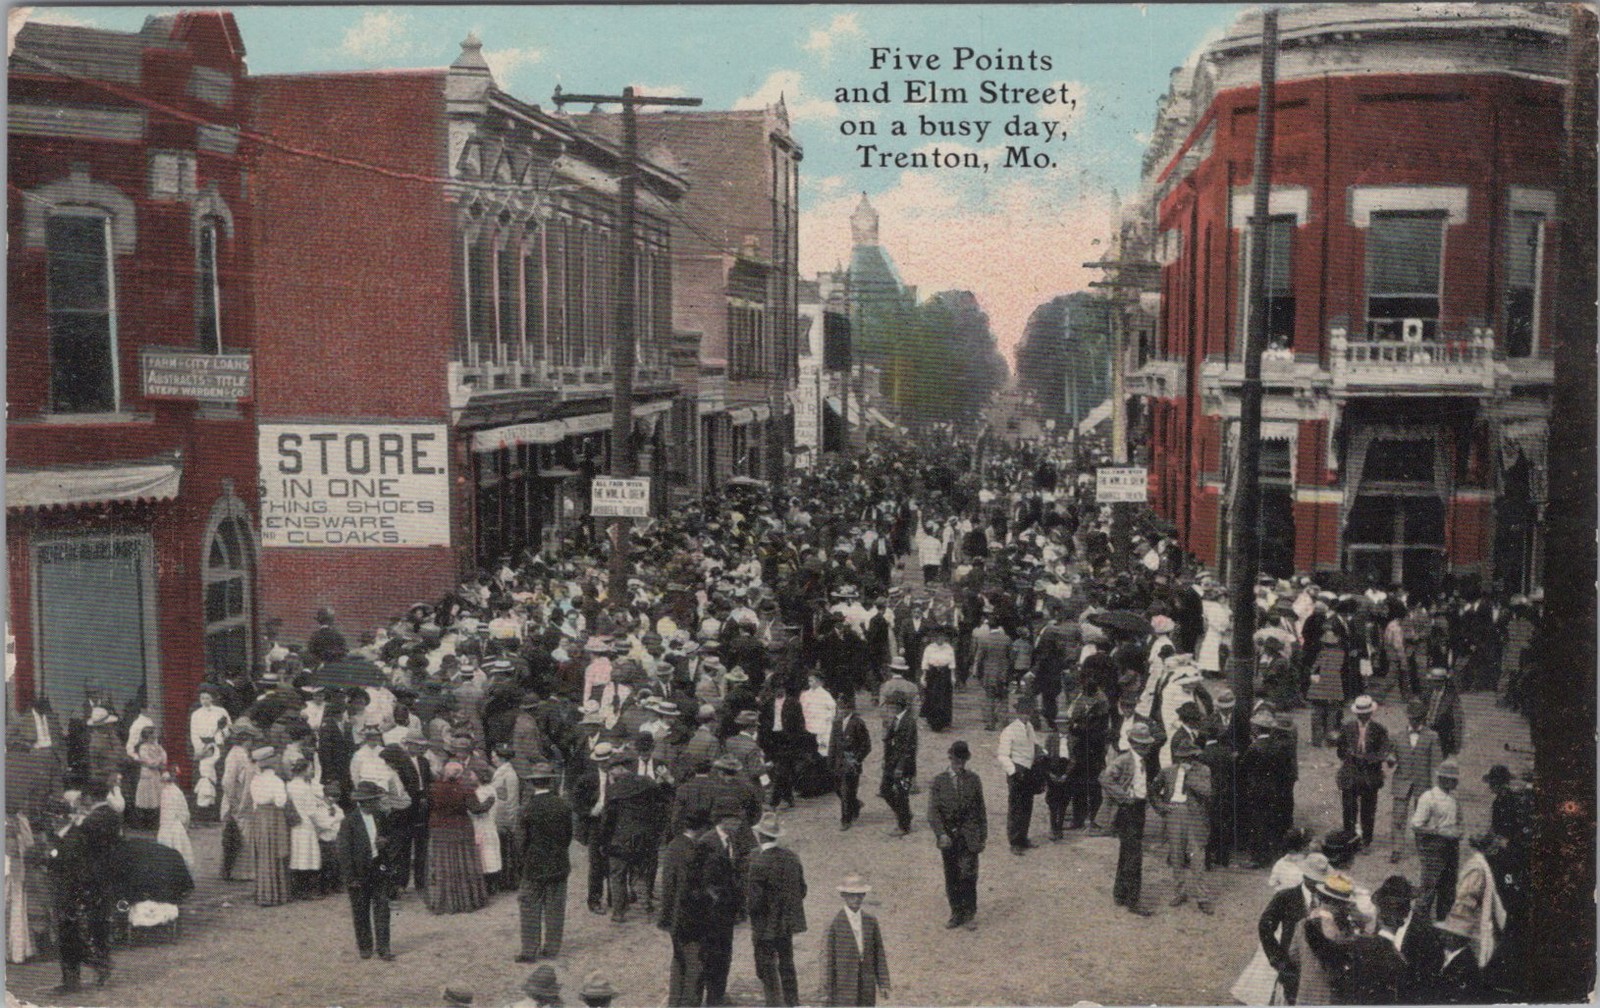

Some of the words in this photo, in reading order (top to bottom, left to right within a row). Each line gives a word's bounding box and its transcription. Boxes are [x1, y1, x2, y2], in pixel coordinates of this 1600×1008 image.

[214, 360, 250, 371] LOANS
[217, 376, 246, 387] TITLE
[278, 433, 445, 474] STORE.
[282, 479, 313, 498] IN
[328, 479, 400, 498] ONE
[346, 500, 434, 514] SHOES
[288, 530, 407, 544] CLOAKS.
